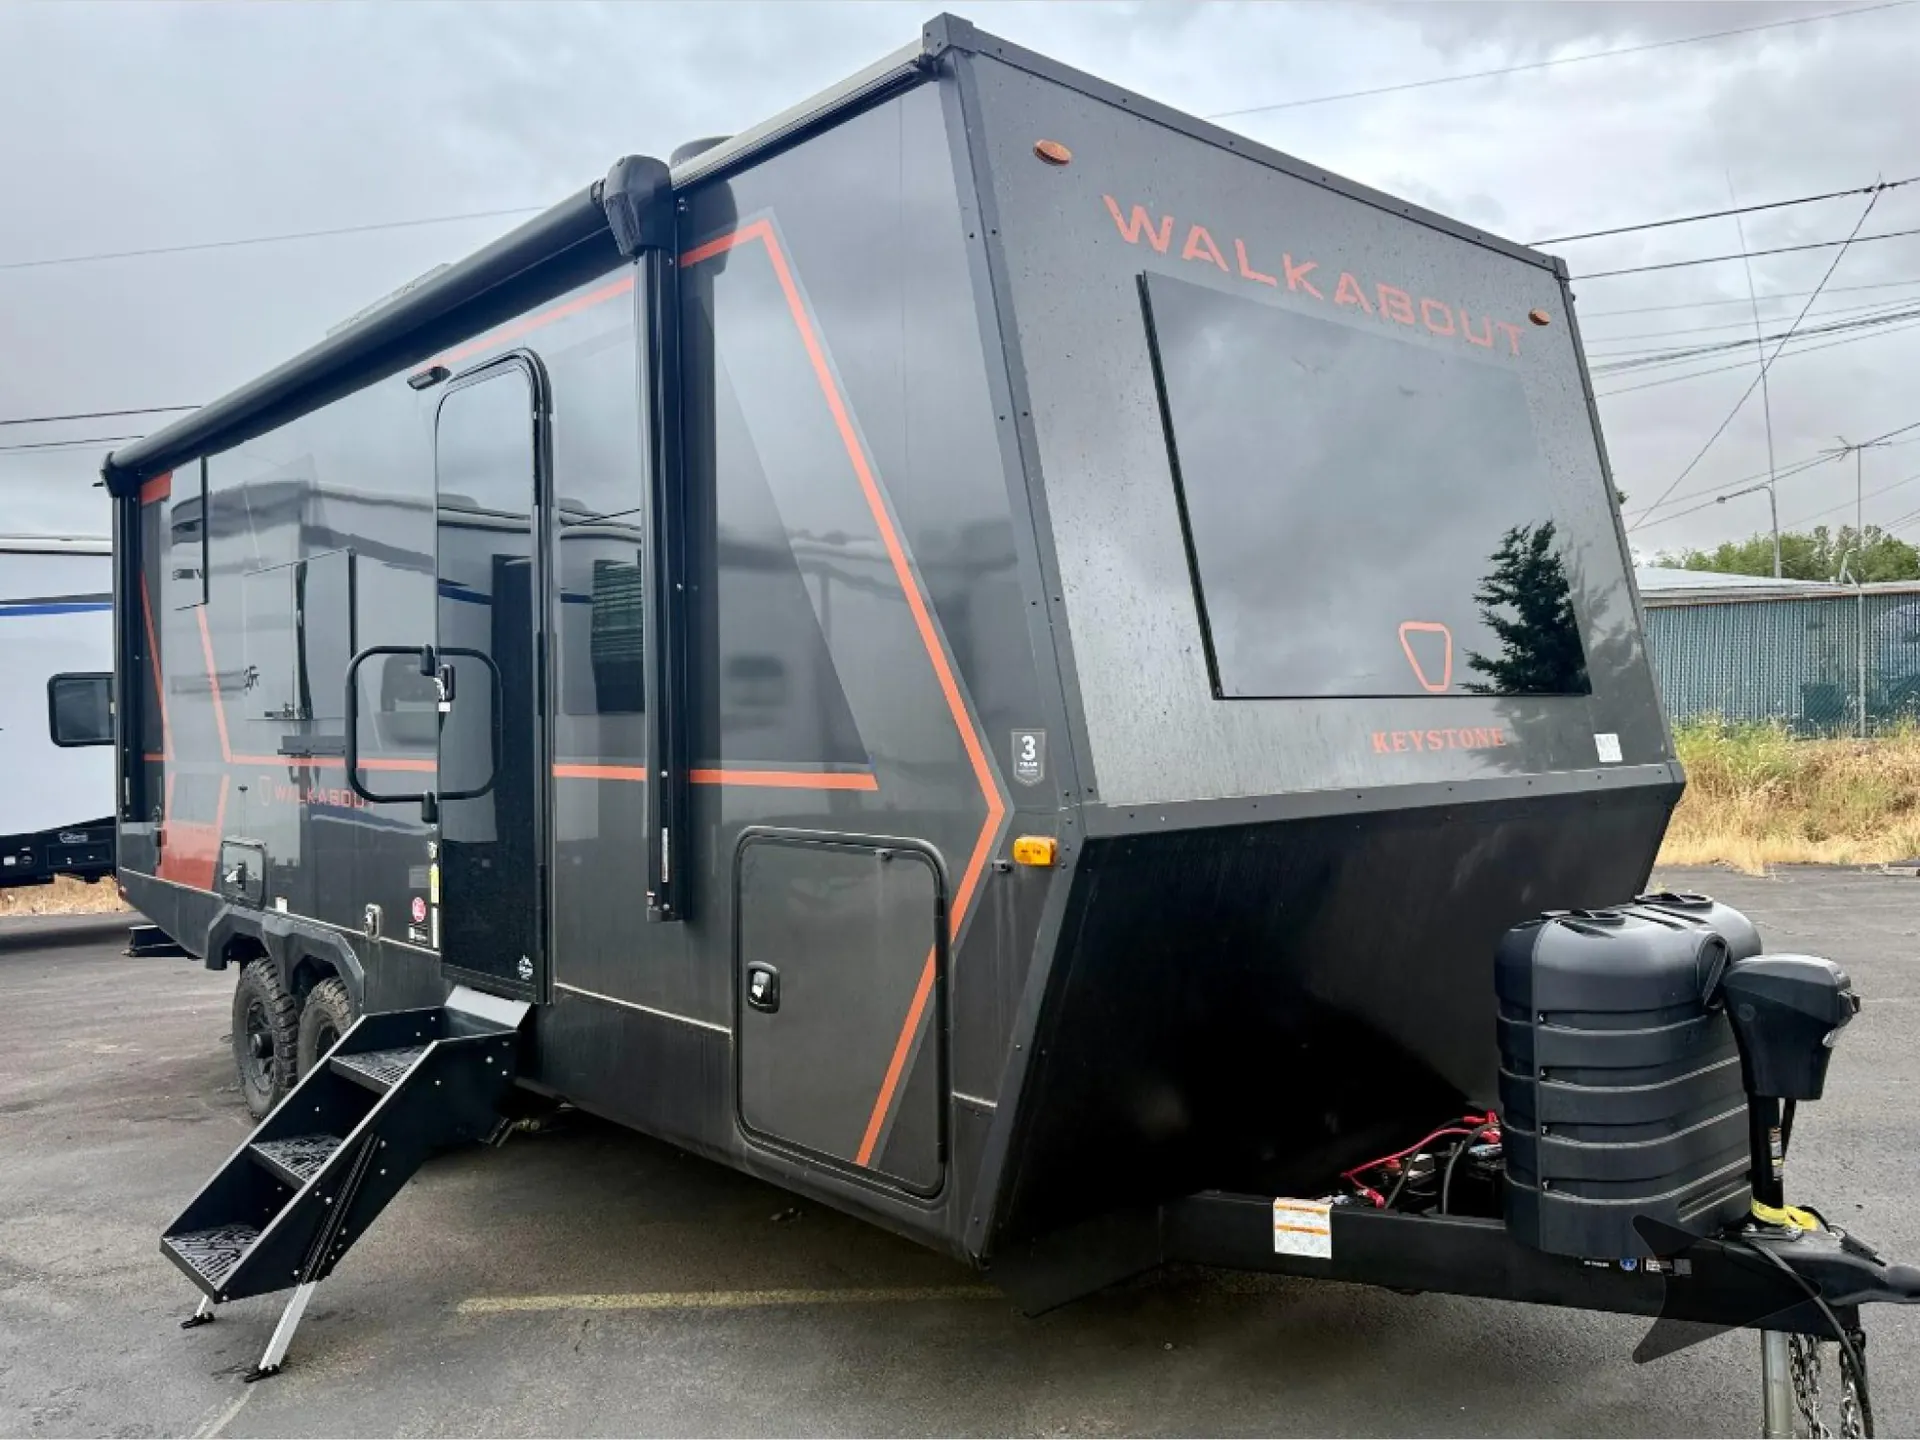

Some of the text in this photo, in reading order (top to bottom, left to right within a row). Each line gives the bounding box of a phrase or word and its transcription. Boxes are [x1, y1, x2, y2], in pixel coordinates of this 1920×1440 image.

[1103, 194, 1526, 357] WALKABOUT
[1021, 735, 1036, 761] 3
[1371, 727, 1507, 753] KEYSTONE
